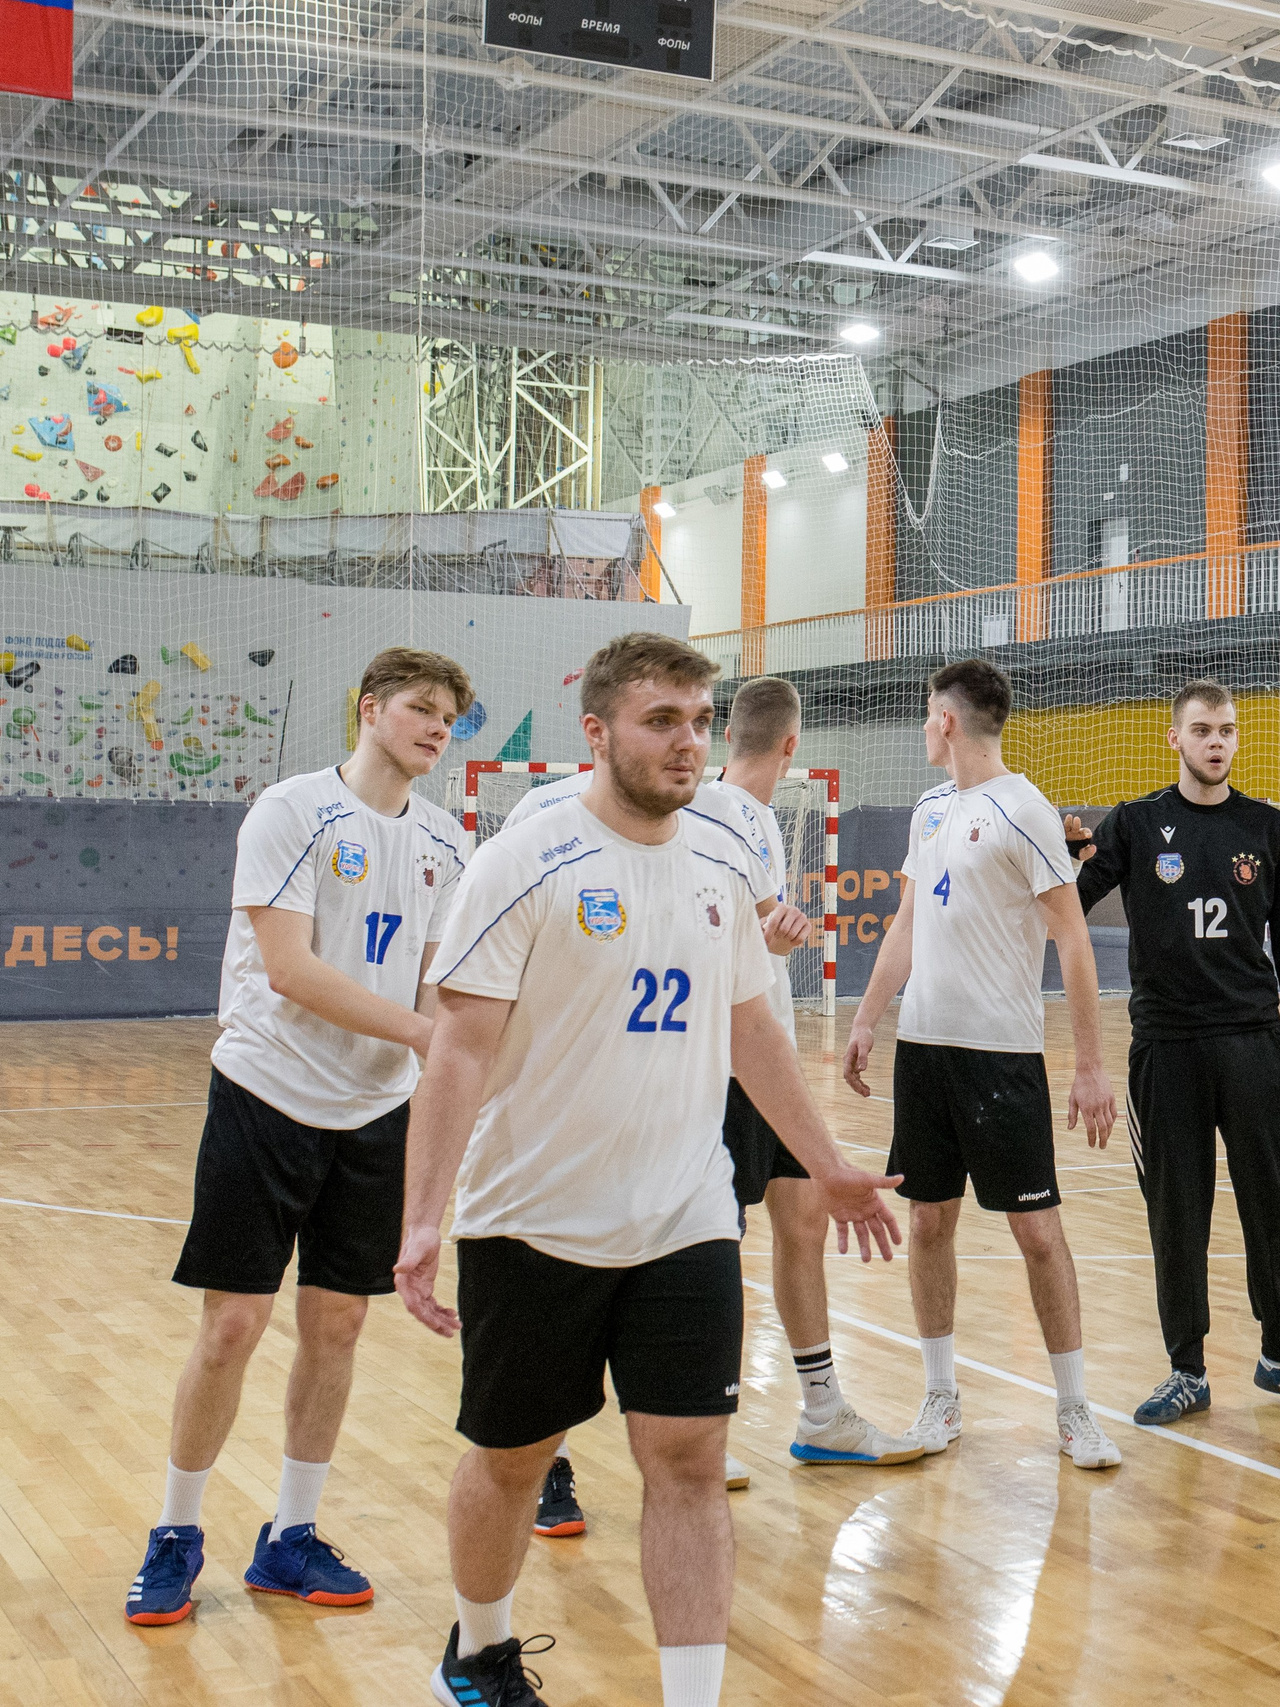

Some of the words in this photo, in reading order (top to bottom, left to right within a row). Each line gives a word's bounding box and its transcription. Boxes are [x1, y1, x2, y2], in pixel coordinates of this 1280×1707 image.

[508, 12, 542, 26] ФОЛЫ
[581, 18, 621, 34] ВРЕМЯ
[657, 37, 690, 50] ФОЛЫ
[933, 868, 951, 906] 4
[1187, 897, 1228, 939] 12
[4, 925, 179, 967] ДЕСЬ!
[365, 911, 403, 965] 17
[626, 967, 691, 1033] 22
[1018, 1189, 1051, 1202] uhlsport
